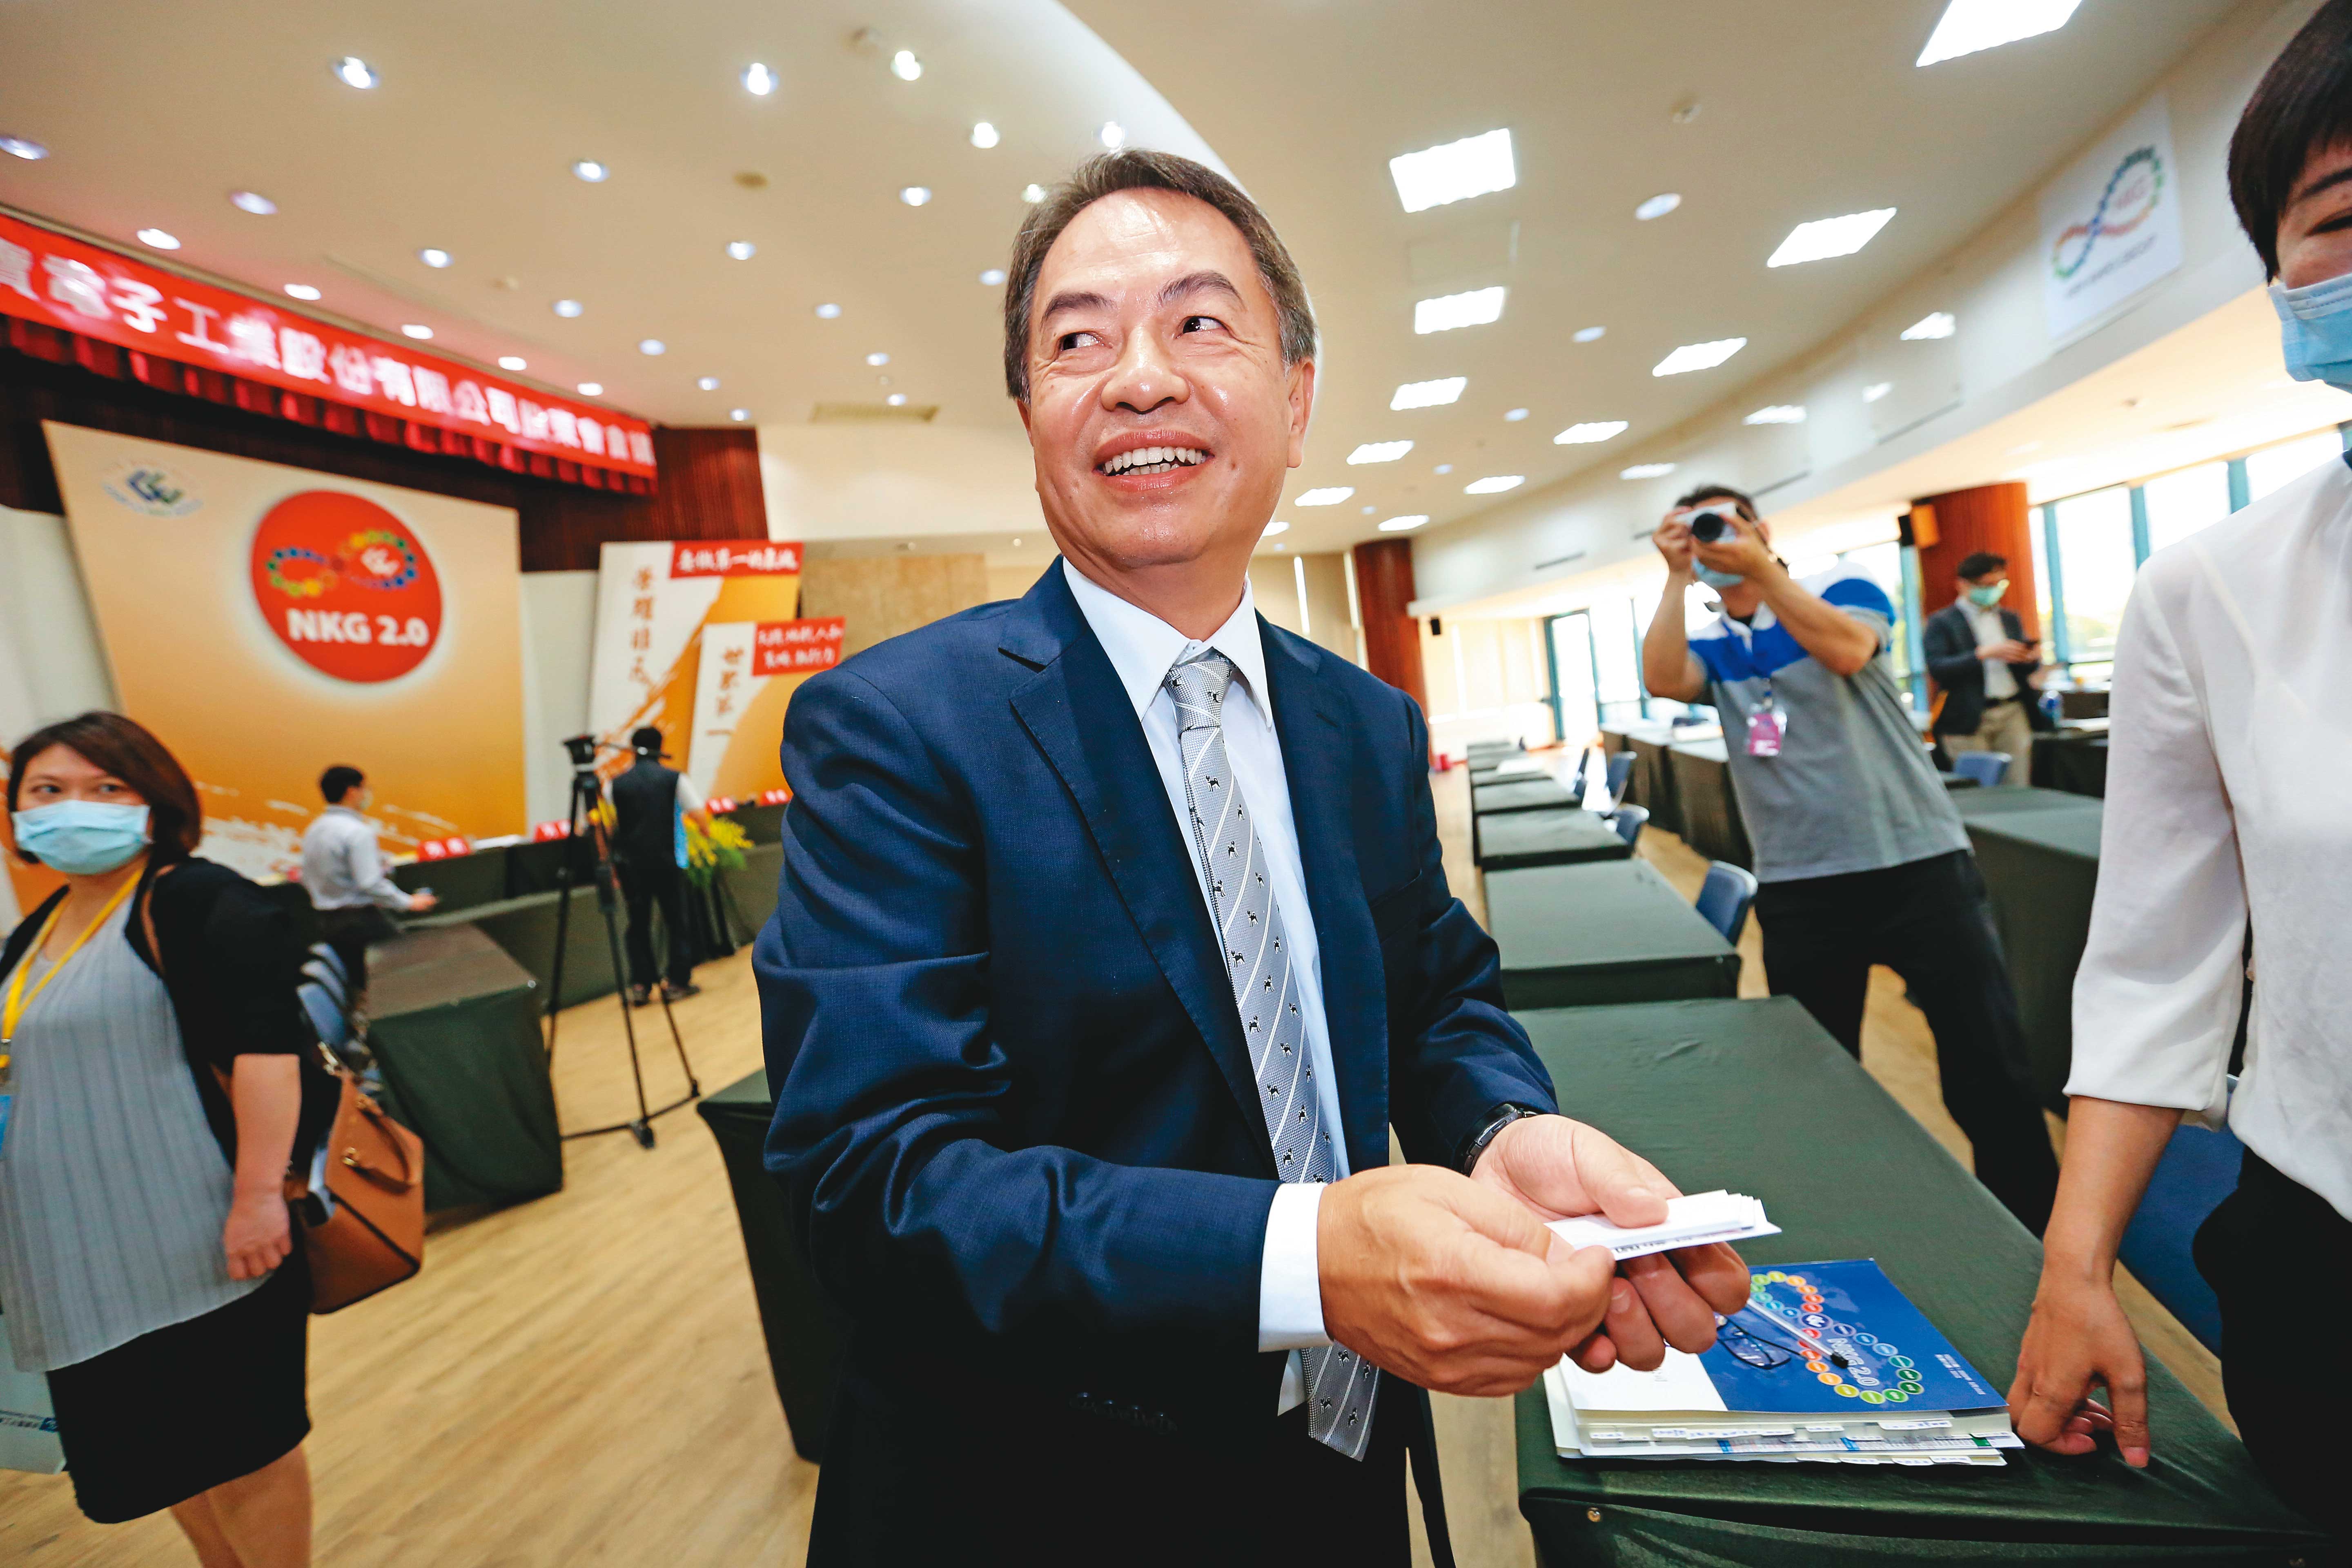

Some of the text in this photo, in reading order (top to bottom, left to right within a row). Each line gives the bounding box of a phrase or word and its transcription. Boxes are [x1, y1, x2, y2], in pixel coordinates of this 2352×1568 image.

[286, 608, 430, 647] NKG 2.0
[1826, 1338, 1880, 1386] NKG 2.0
